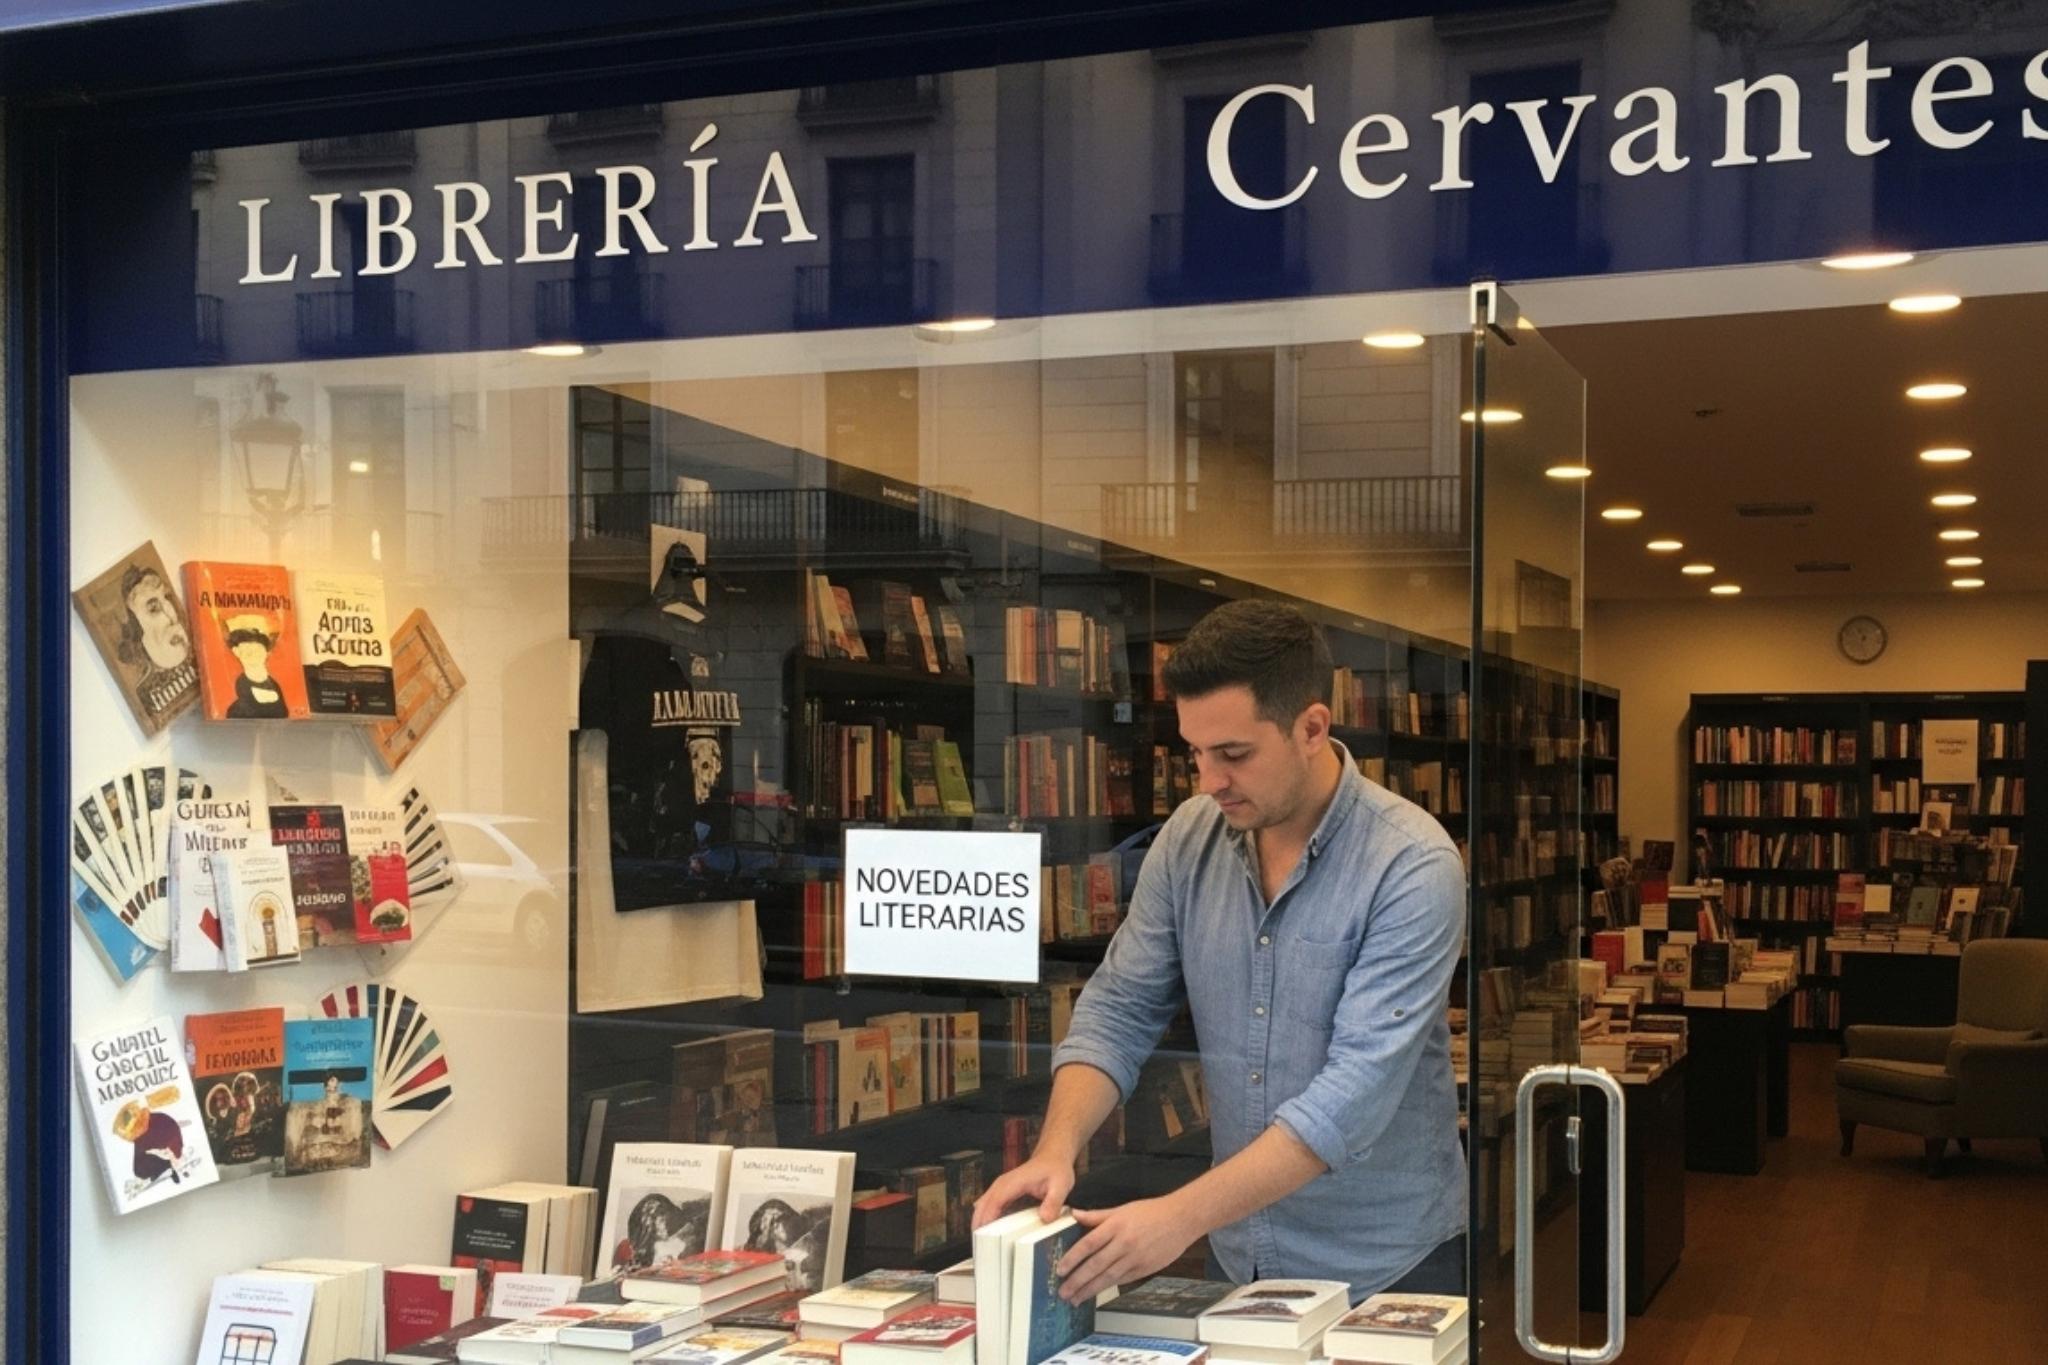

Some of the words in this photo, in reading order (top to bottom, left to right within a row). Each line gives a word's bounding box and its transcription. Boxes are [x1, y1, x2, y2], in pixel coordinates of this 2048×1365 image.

[238, 123, 818, 284] LIBRERÍA
[857, 867, 1029, 898] NOVEDADES
[860, 902, 1025, 933] LITERARIAS
